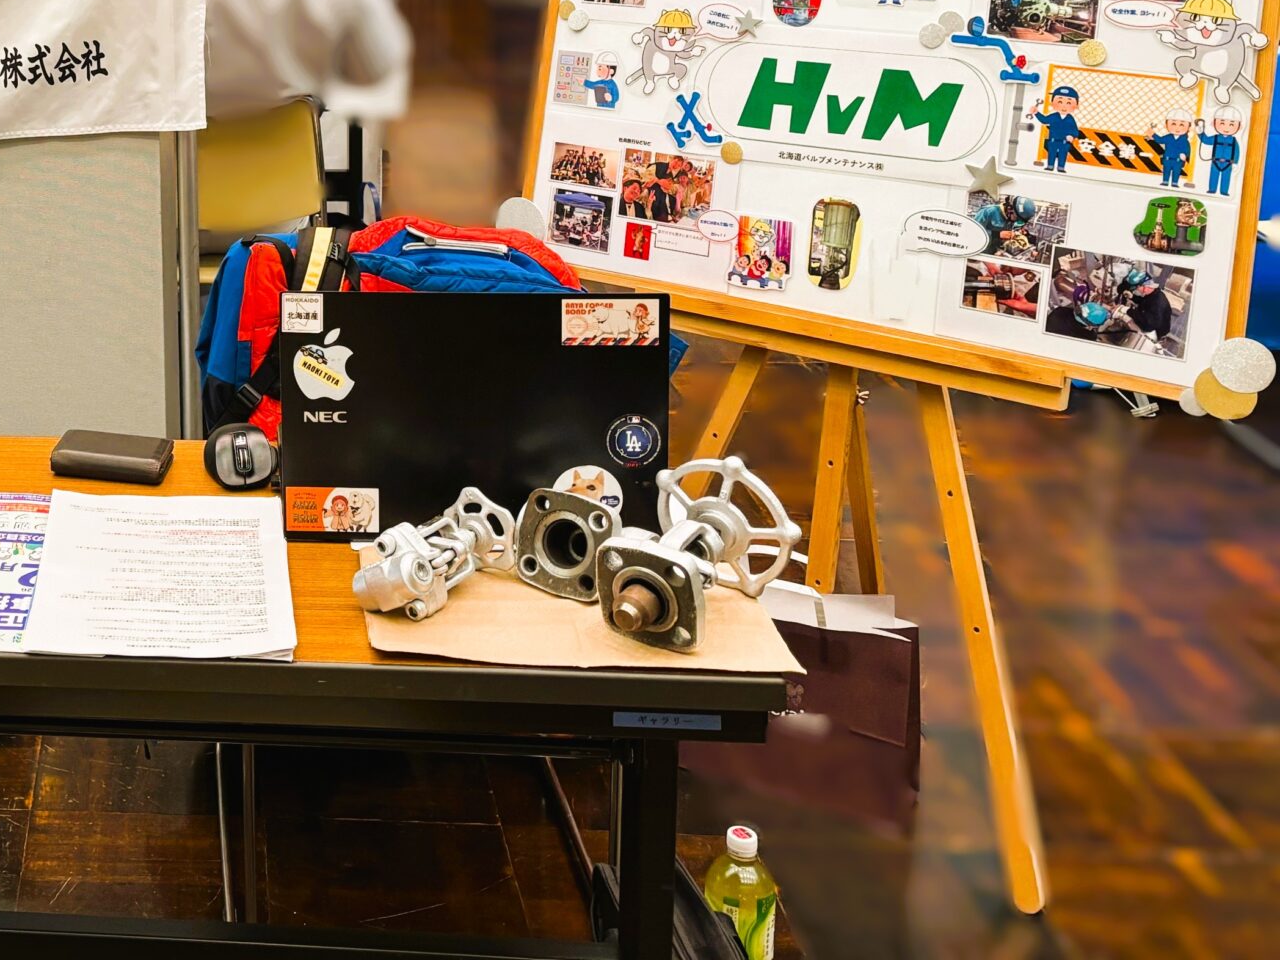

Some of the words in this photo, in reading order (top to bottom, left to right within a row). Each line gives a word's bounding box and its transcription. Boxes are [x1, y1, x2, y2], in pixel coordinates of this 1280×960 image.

[737, 57, 964, 147] HvM
[1078, 138, 1154, 160] 安全第一
[287, 311, 319, 321] 北海道産
[301, 360, 323, 377] NAOKI
[322, 371, 340, 387] TOYA
[303, 411, 348, 424] NEC
[625, 430, 642, 452] LA
[638, 714, 695, 725] ギャラリー
